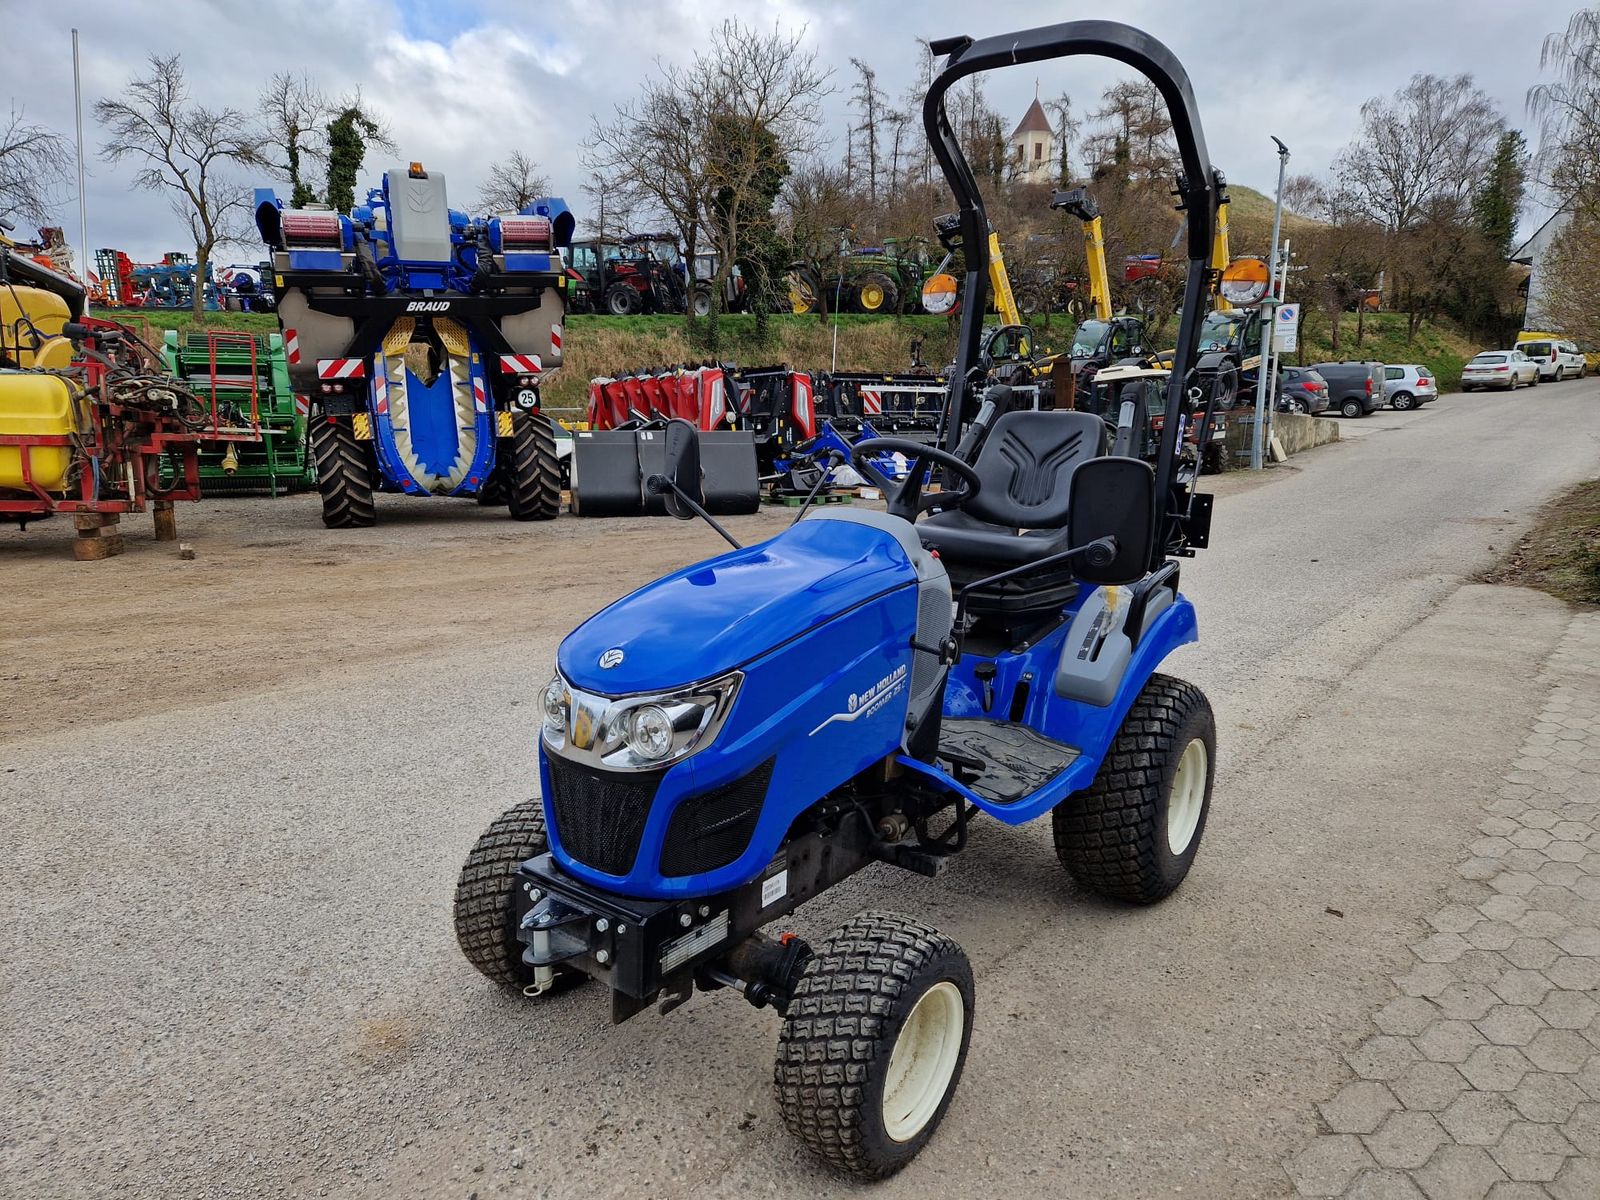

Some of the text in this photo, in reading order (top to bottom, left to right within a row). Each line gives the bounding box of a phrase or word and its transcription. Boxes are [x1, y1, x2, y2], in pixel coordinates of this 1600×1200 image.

[406, 301, 450, 312] BRAUD
[521, 392, 533, 404] 25
[858, 663, 906, 707] NEW HOLLAND
[866, 691, 893, 718] BOOMER
